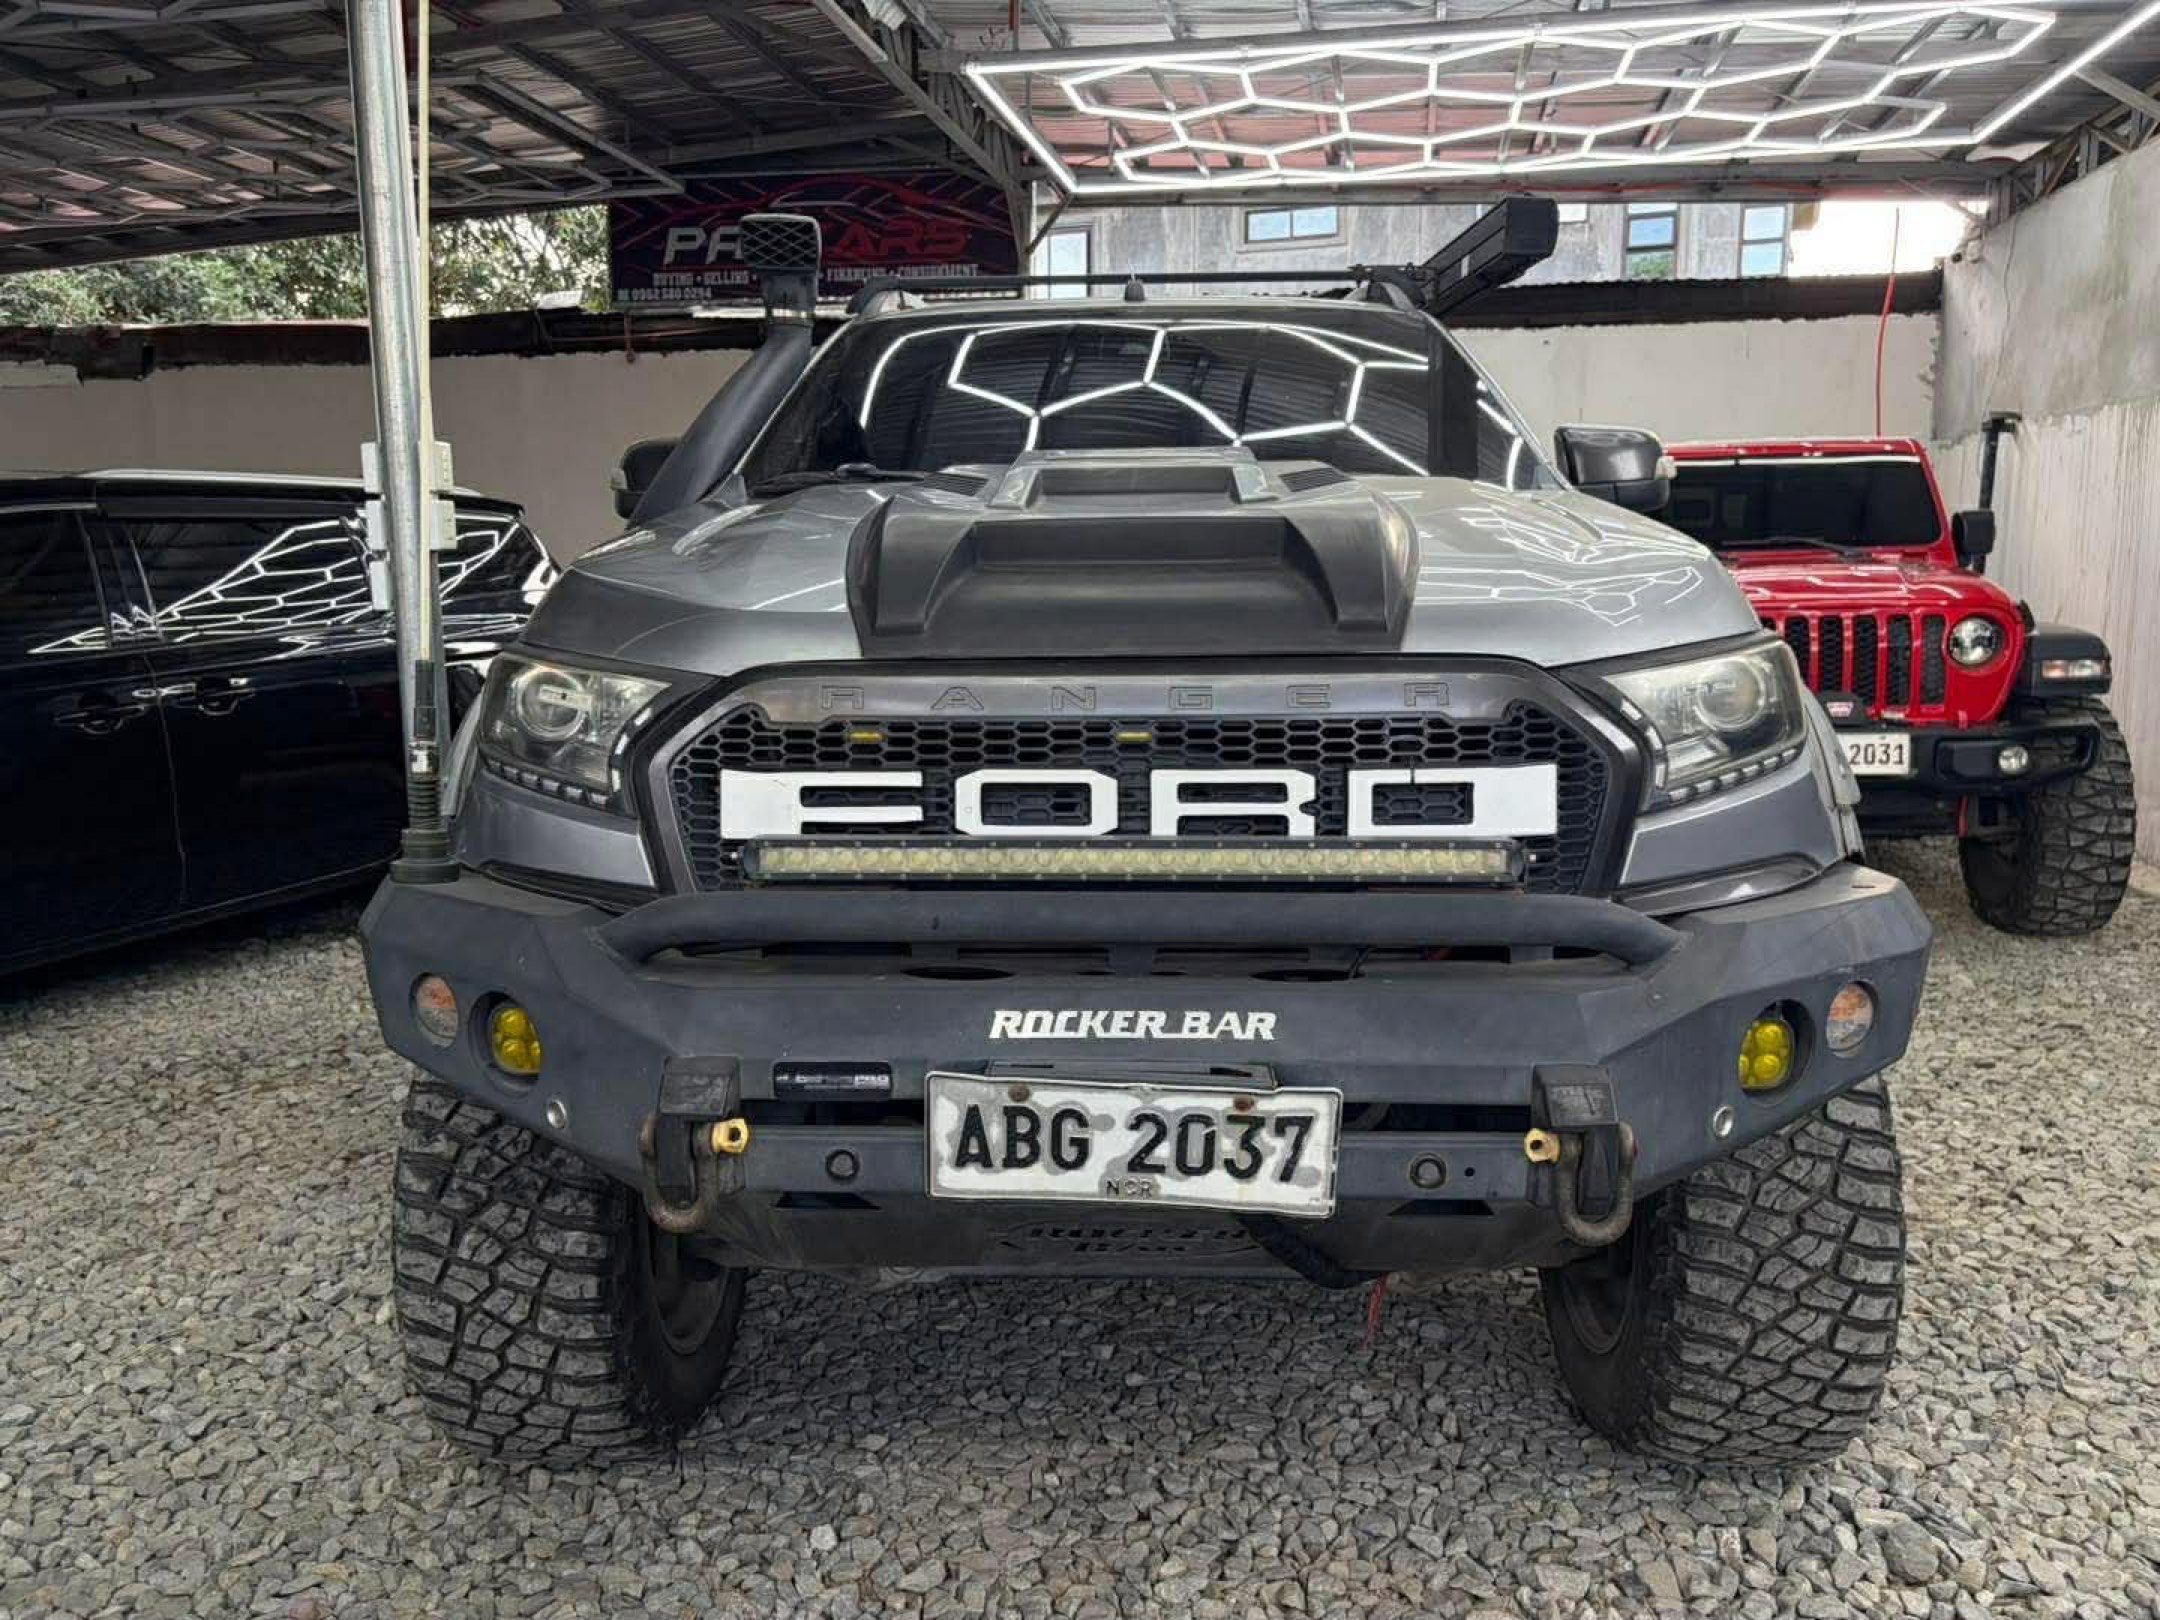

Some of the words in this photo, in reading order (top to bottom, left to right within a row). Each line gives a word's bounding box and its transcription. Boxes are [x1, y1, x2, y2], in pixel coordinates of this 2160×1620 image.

[819, 682, 1449, 711] RANGER
[1848, 742, 1905, 766] 2031
[719, 763, 1559, 839] FORD
[988, 1010, 1169, 1039] ROCKER
[1182, 1010, 1278, 1039] BAR
[955, 1103, 1091, 1171] ABG
[1125, 1111, 1315, 1183] 2037
[1105, 1179, 1155, 1199] NCR
